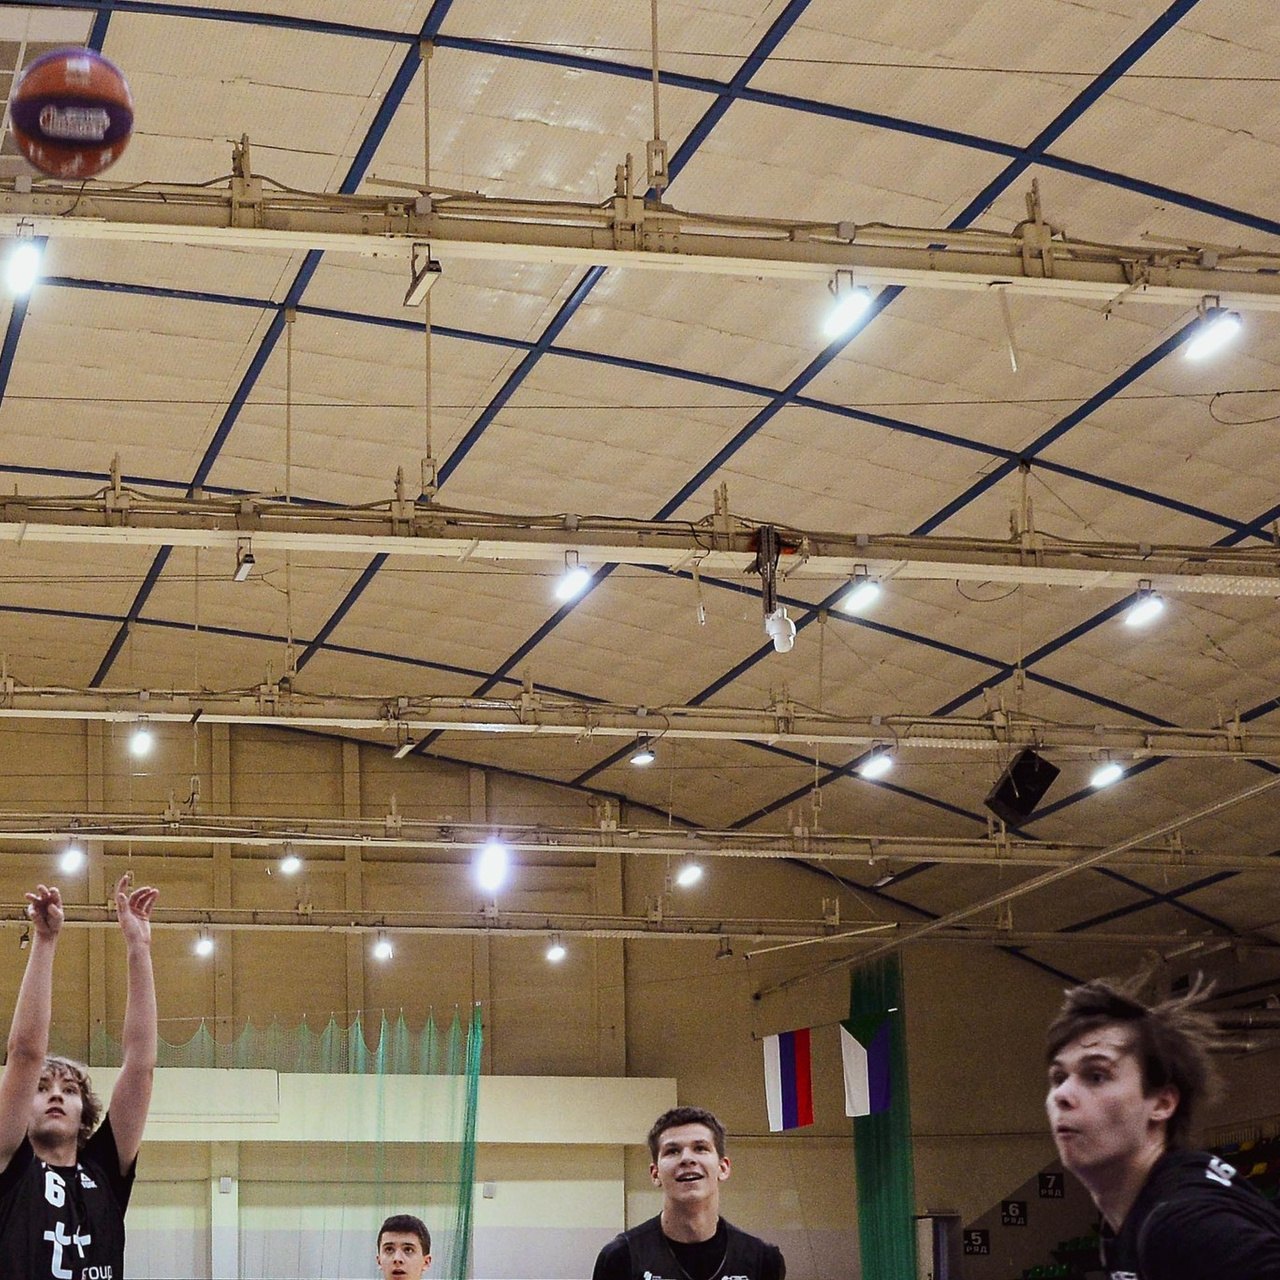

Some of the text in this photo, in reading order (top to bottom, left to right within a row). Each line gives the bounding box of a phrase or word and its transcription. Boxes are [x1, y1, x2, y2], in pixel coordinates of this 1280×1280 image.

[1046, 1175, 1056, 1188] 7
[45, 1171, 66, 1208] 6
[1041, 1189, 1062, 1197] РЯД
[1008, 1203, 1019, 1216] 6
[1003, 1216, 1025, 1224] РЯД
[971, 1232, 982, 1245] 5
[966, 1246, 988, 1254] РЯД
